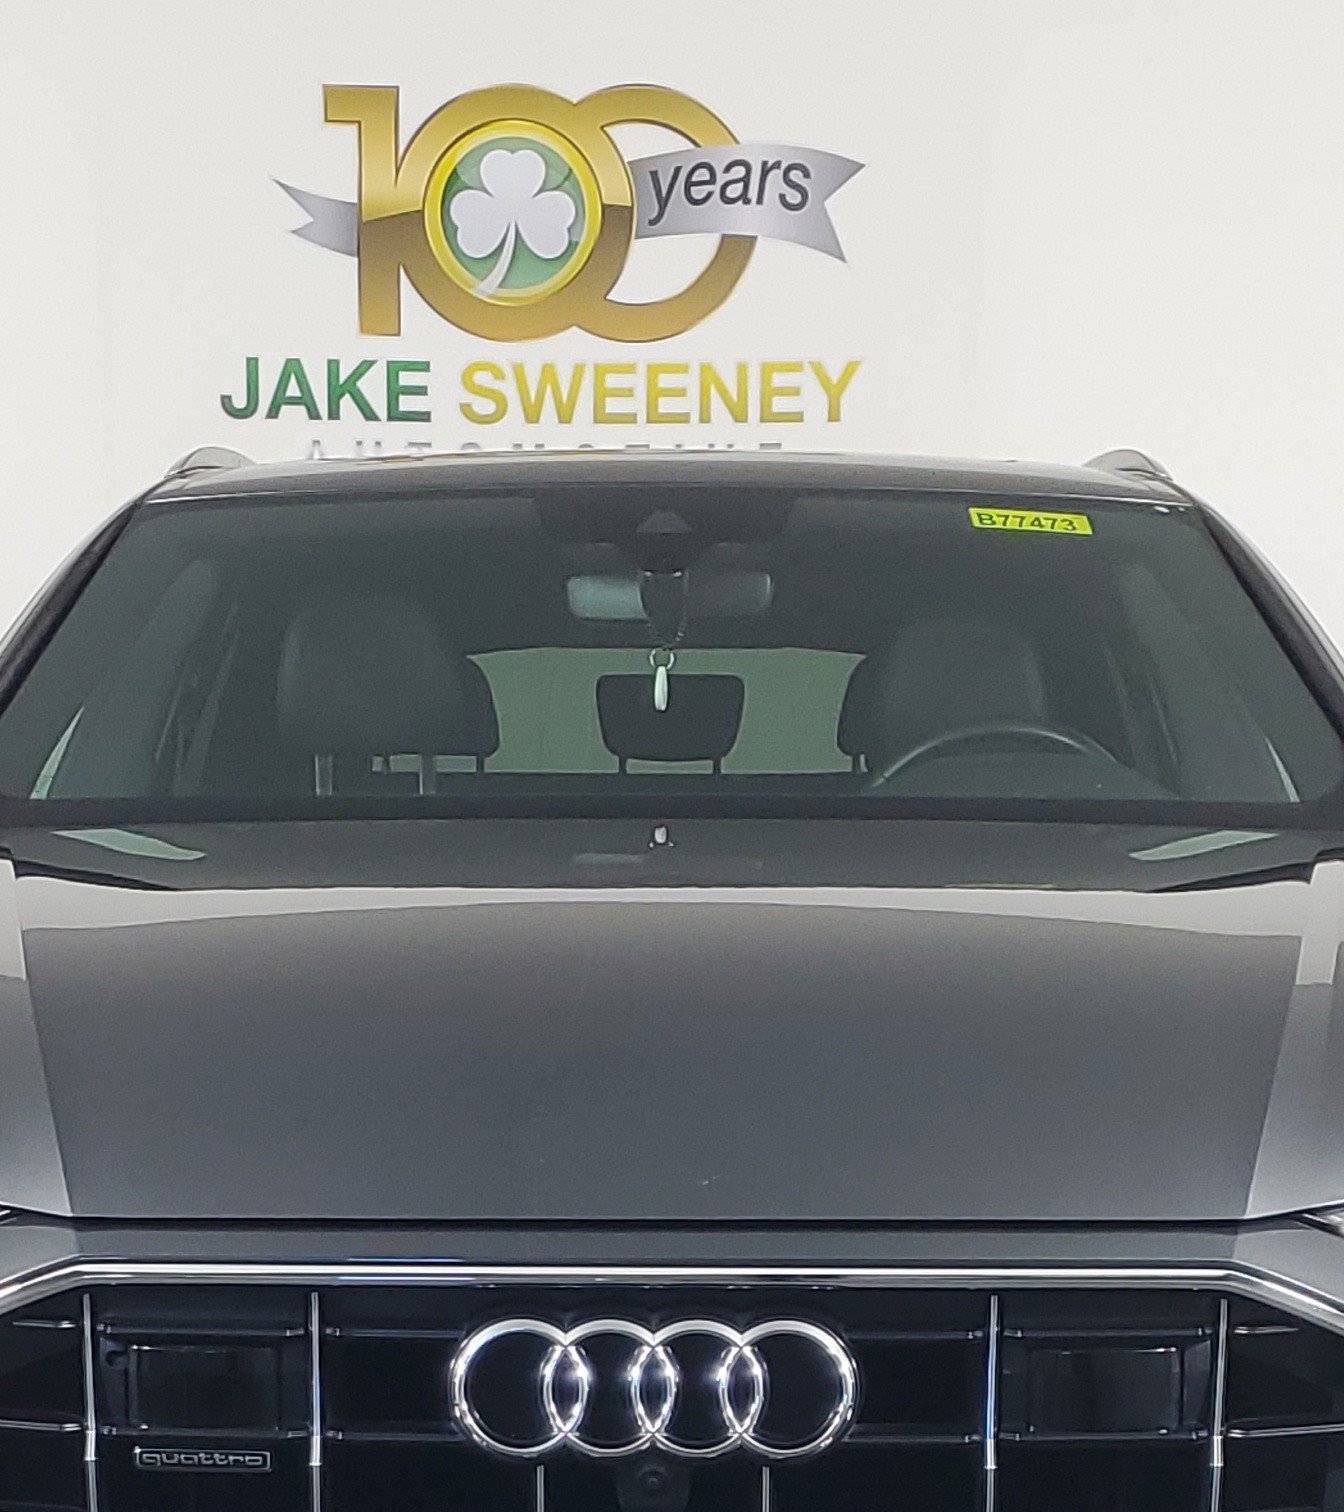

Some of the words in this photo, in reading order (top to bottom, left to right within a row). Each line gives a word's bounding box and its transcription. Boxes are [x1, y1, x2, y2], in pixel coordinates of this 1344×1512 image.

[322, 83, 757, 343] 100
[647, 157, 812, 227] years
[219, 356, 432, 421] JAKE
[458, 359, 862, 424] SWEENEY
[976, 512, 1076, 531] B77473
[142, 1453, 263, 1467] quattro
